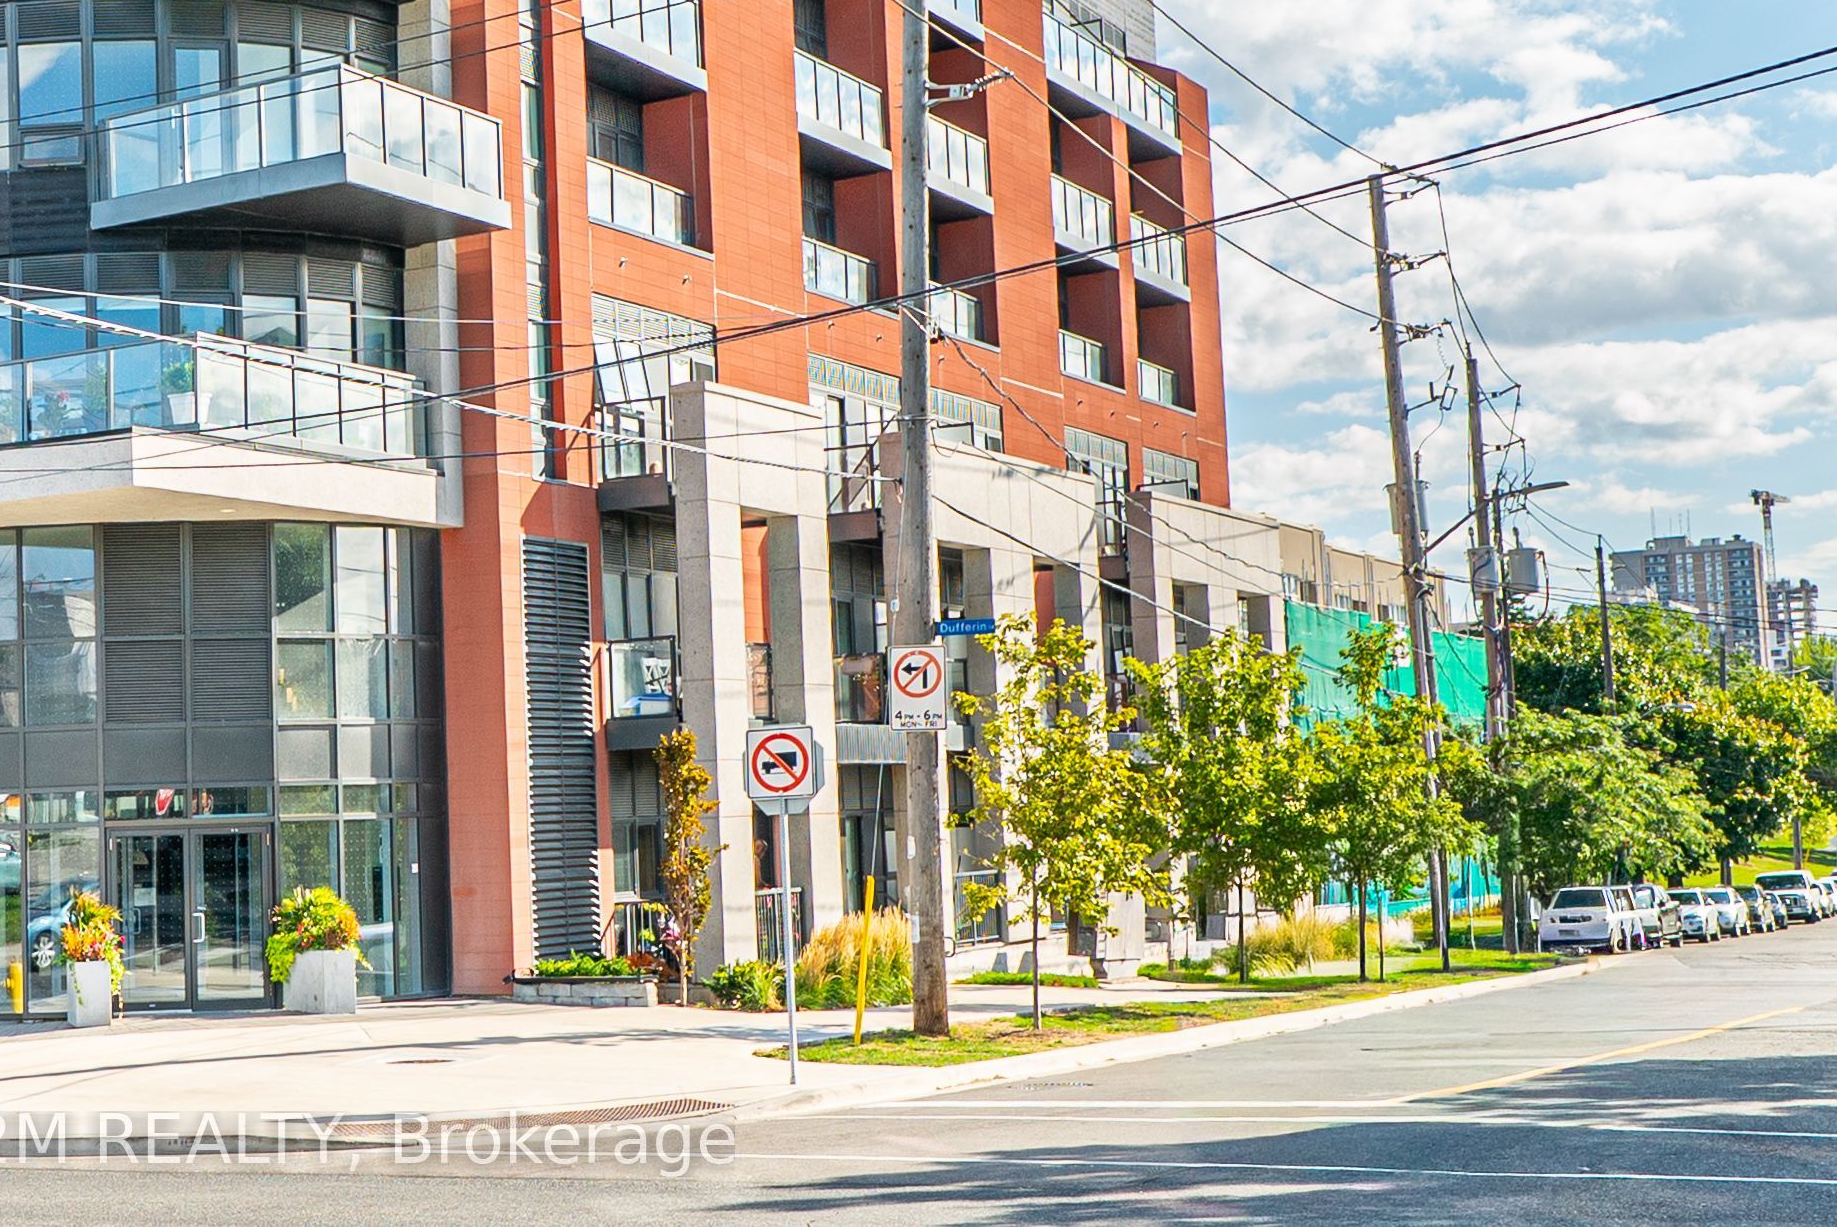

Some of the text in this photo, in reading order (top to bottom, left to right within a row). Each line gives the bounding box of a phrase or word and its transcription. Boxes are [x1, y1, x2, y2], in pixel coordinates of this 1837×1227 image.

[940, 622, 987, 633] Dufferin
[895, 710, 902, 720] 4
[924, 710, 931, 720] 6
